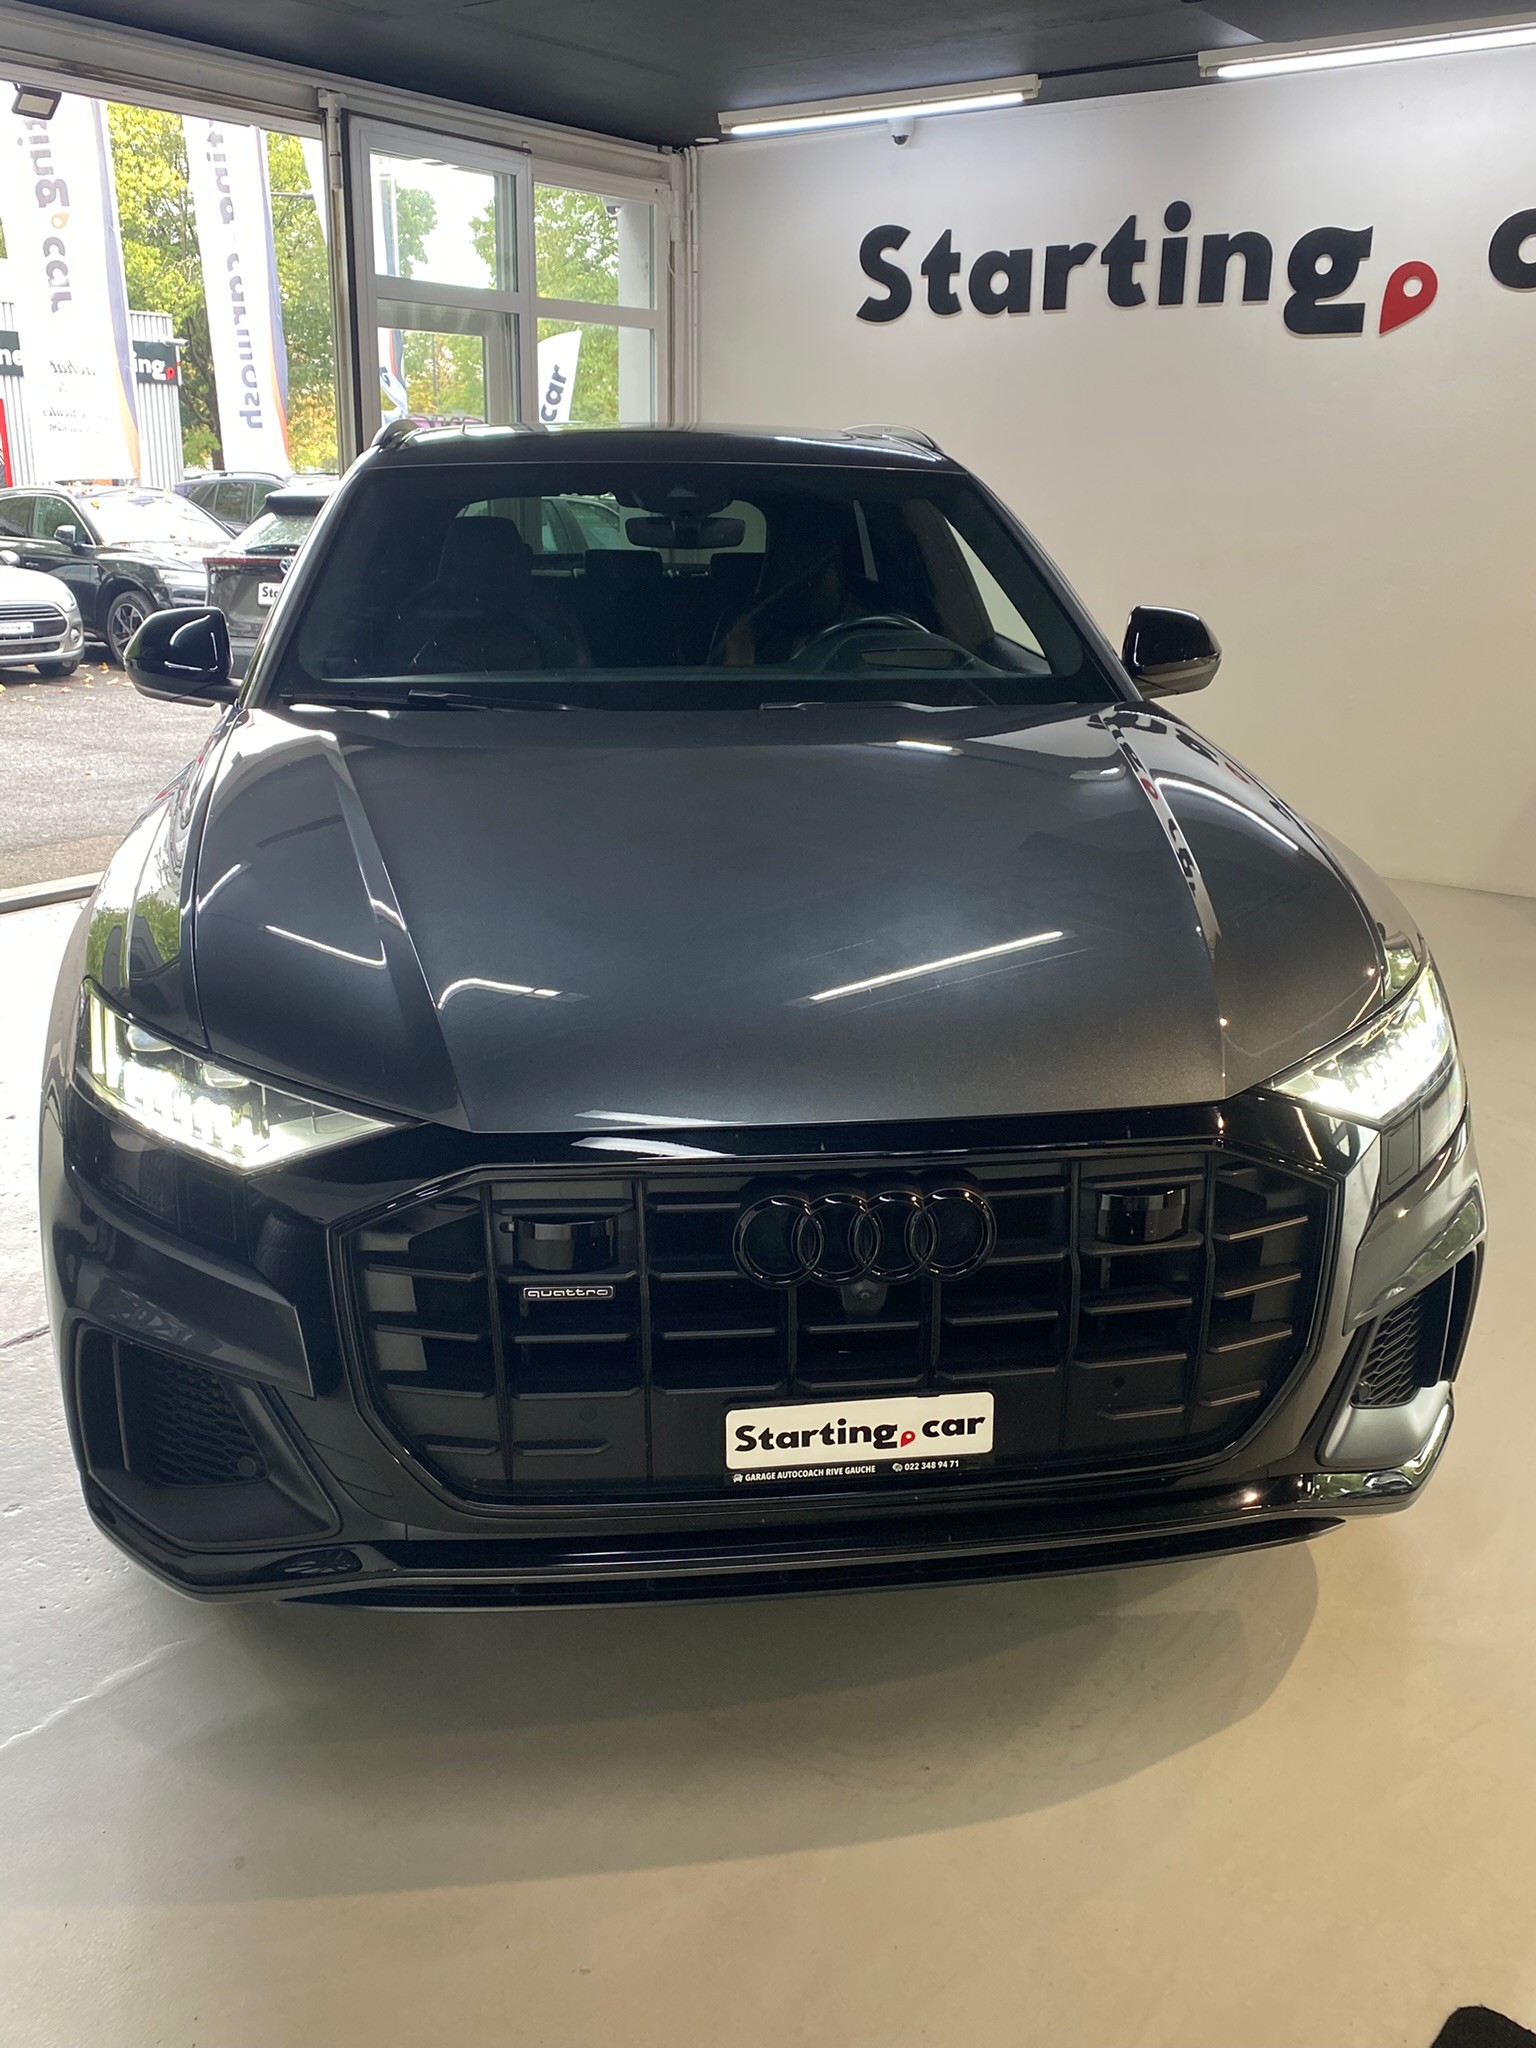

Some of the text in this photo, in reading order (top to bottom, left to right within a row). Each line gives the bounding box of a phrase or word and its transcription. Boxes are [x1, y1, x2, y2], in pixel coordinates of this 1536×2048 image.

[856, 200, 1374, 335] Starting
[540, 364, 567, 422] car
[528, 1289, 608, 1298] quattro
[735, 1416, 985, 1452] Starting car
[745, 1465, 876, 1482] GARAGE AUTOCOACH RIVE GAUCHE
[904, 1460, 959, 1471] 022 348 94 71
